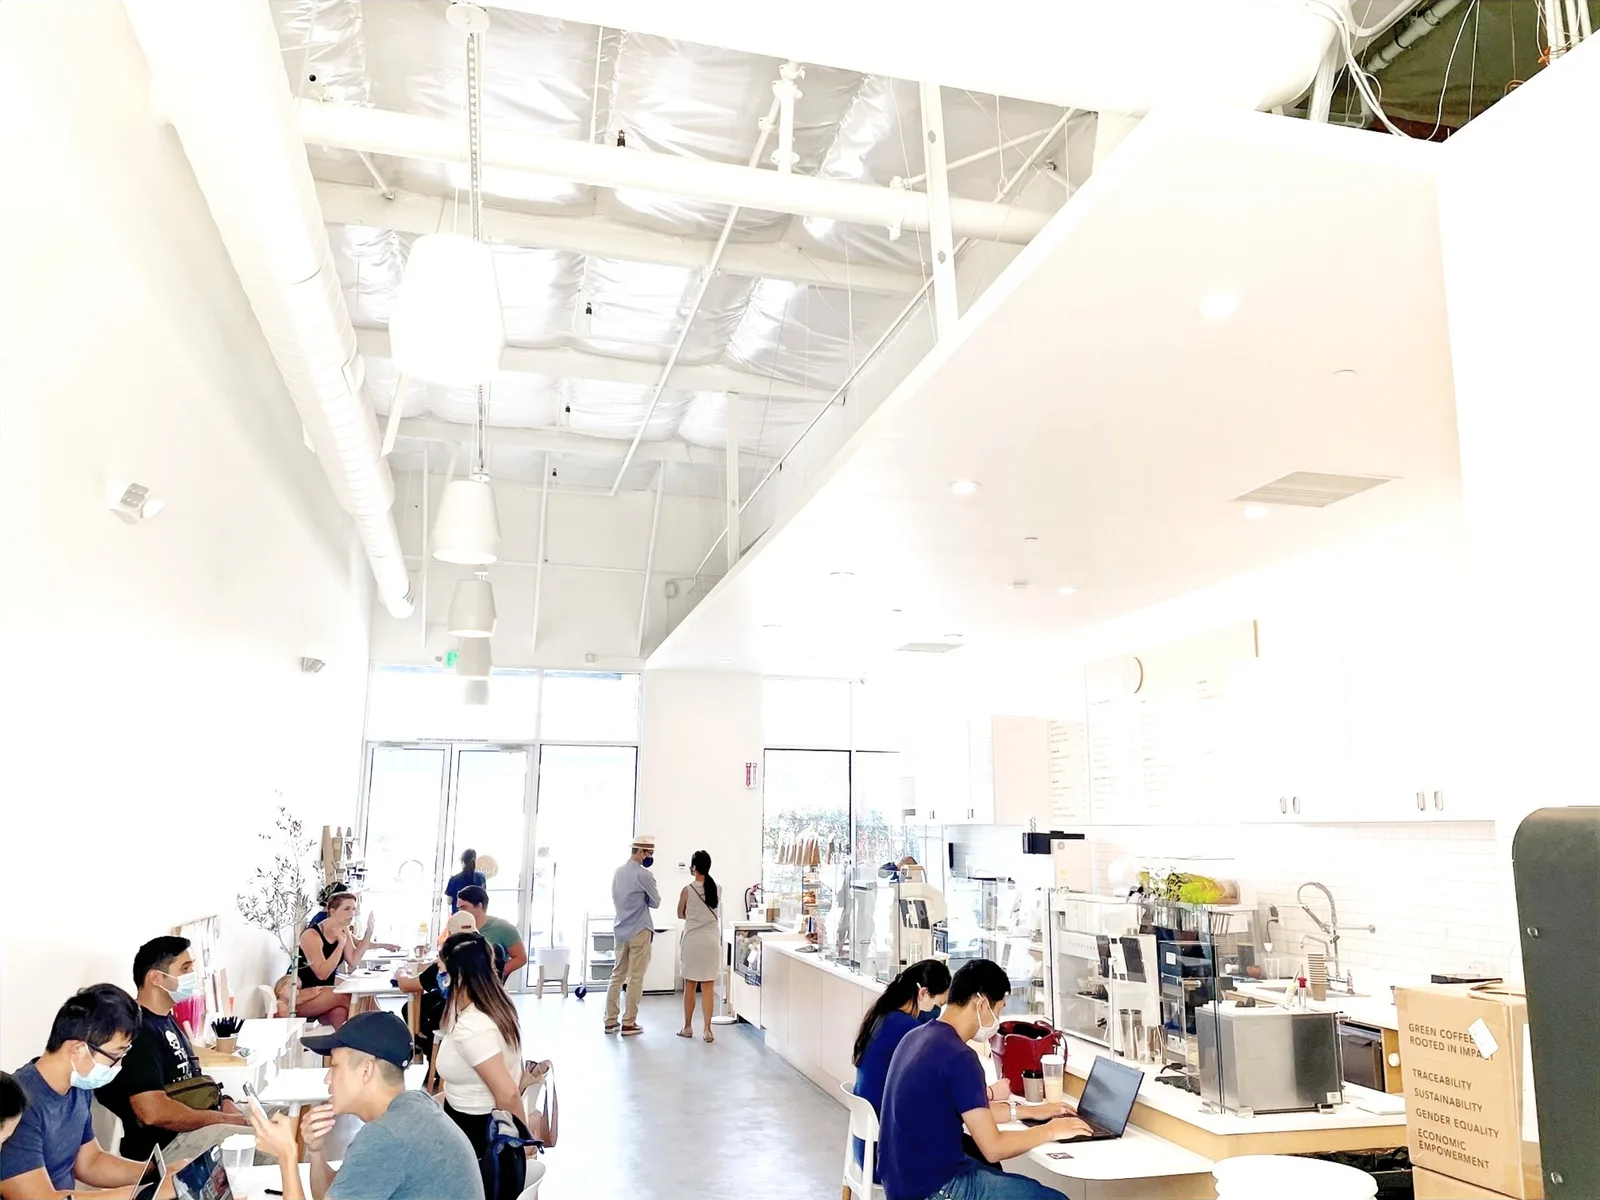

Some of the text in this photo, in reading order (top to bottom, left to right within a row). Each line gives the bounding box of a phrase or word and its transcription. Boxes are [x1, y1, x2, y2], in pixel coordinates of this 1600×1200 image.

[1408, 1023, 1475, 1044] GREEN COFFEE
[1409, 1036, 1494, 1061] ROOTED IN IMPA
[1412, 1068, 1472, 1091] TRACEABILITY
[1414, 1087, 1483, 1113] SUSTAINABILITY
[1415, 1107, 1499, 1139] GENDER EQUALITY
[1417, 1128, 1467, 1151] ECONOMIC
[1418, 1140, 1490, 1169] EMPOWERMENT
